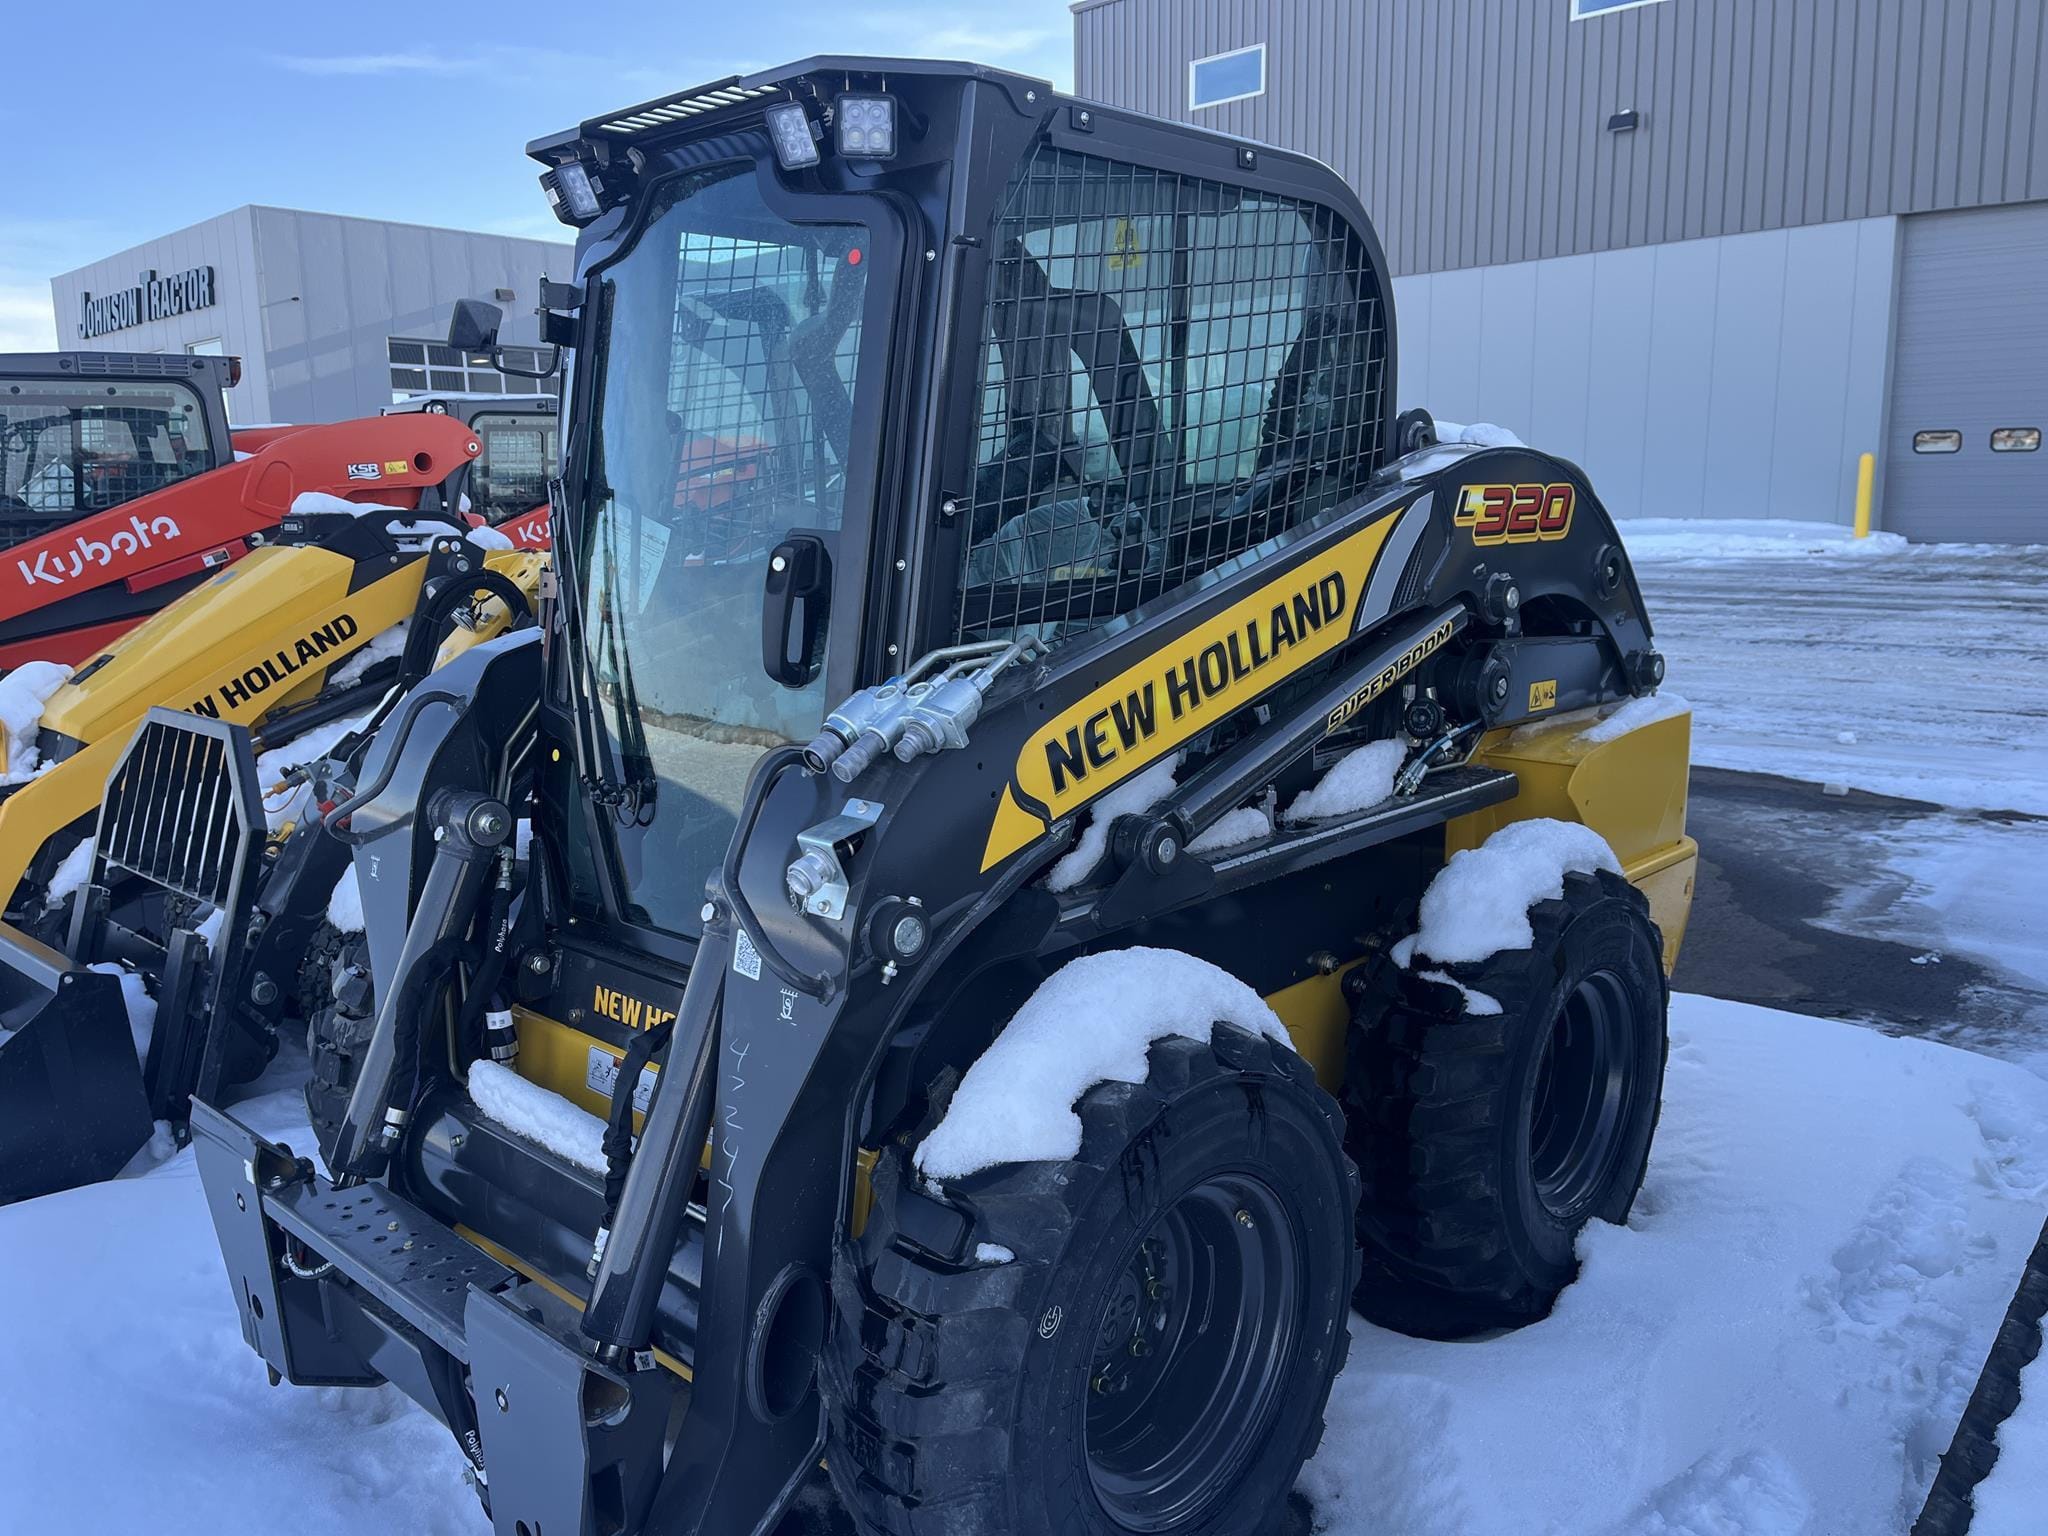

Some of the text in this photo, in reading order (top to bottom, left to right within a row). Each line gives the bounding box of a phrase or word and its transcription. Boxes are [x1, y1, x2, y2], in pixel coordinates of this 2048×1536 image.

[347, 463, 379, 475] KSR
[1454, 483, 1576, 546] L320
[17, 515, 181, 585] Kubota
[219, 614, 358, 709] HOLLAND
[1044, 569, 1346, 796] NEW HOLLAND
[1329, 664, 1397, 733] SUPER
[1397, 620, 1452, 680] BOOM
[593, 984, 642, 1029] NEW
